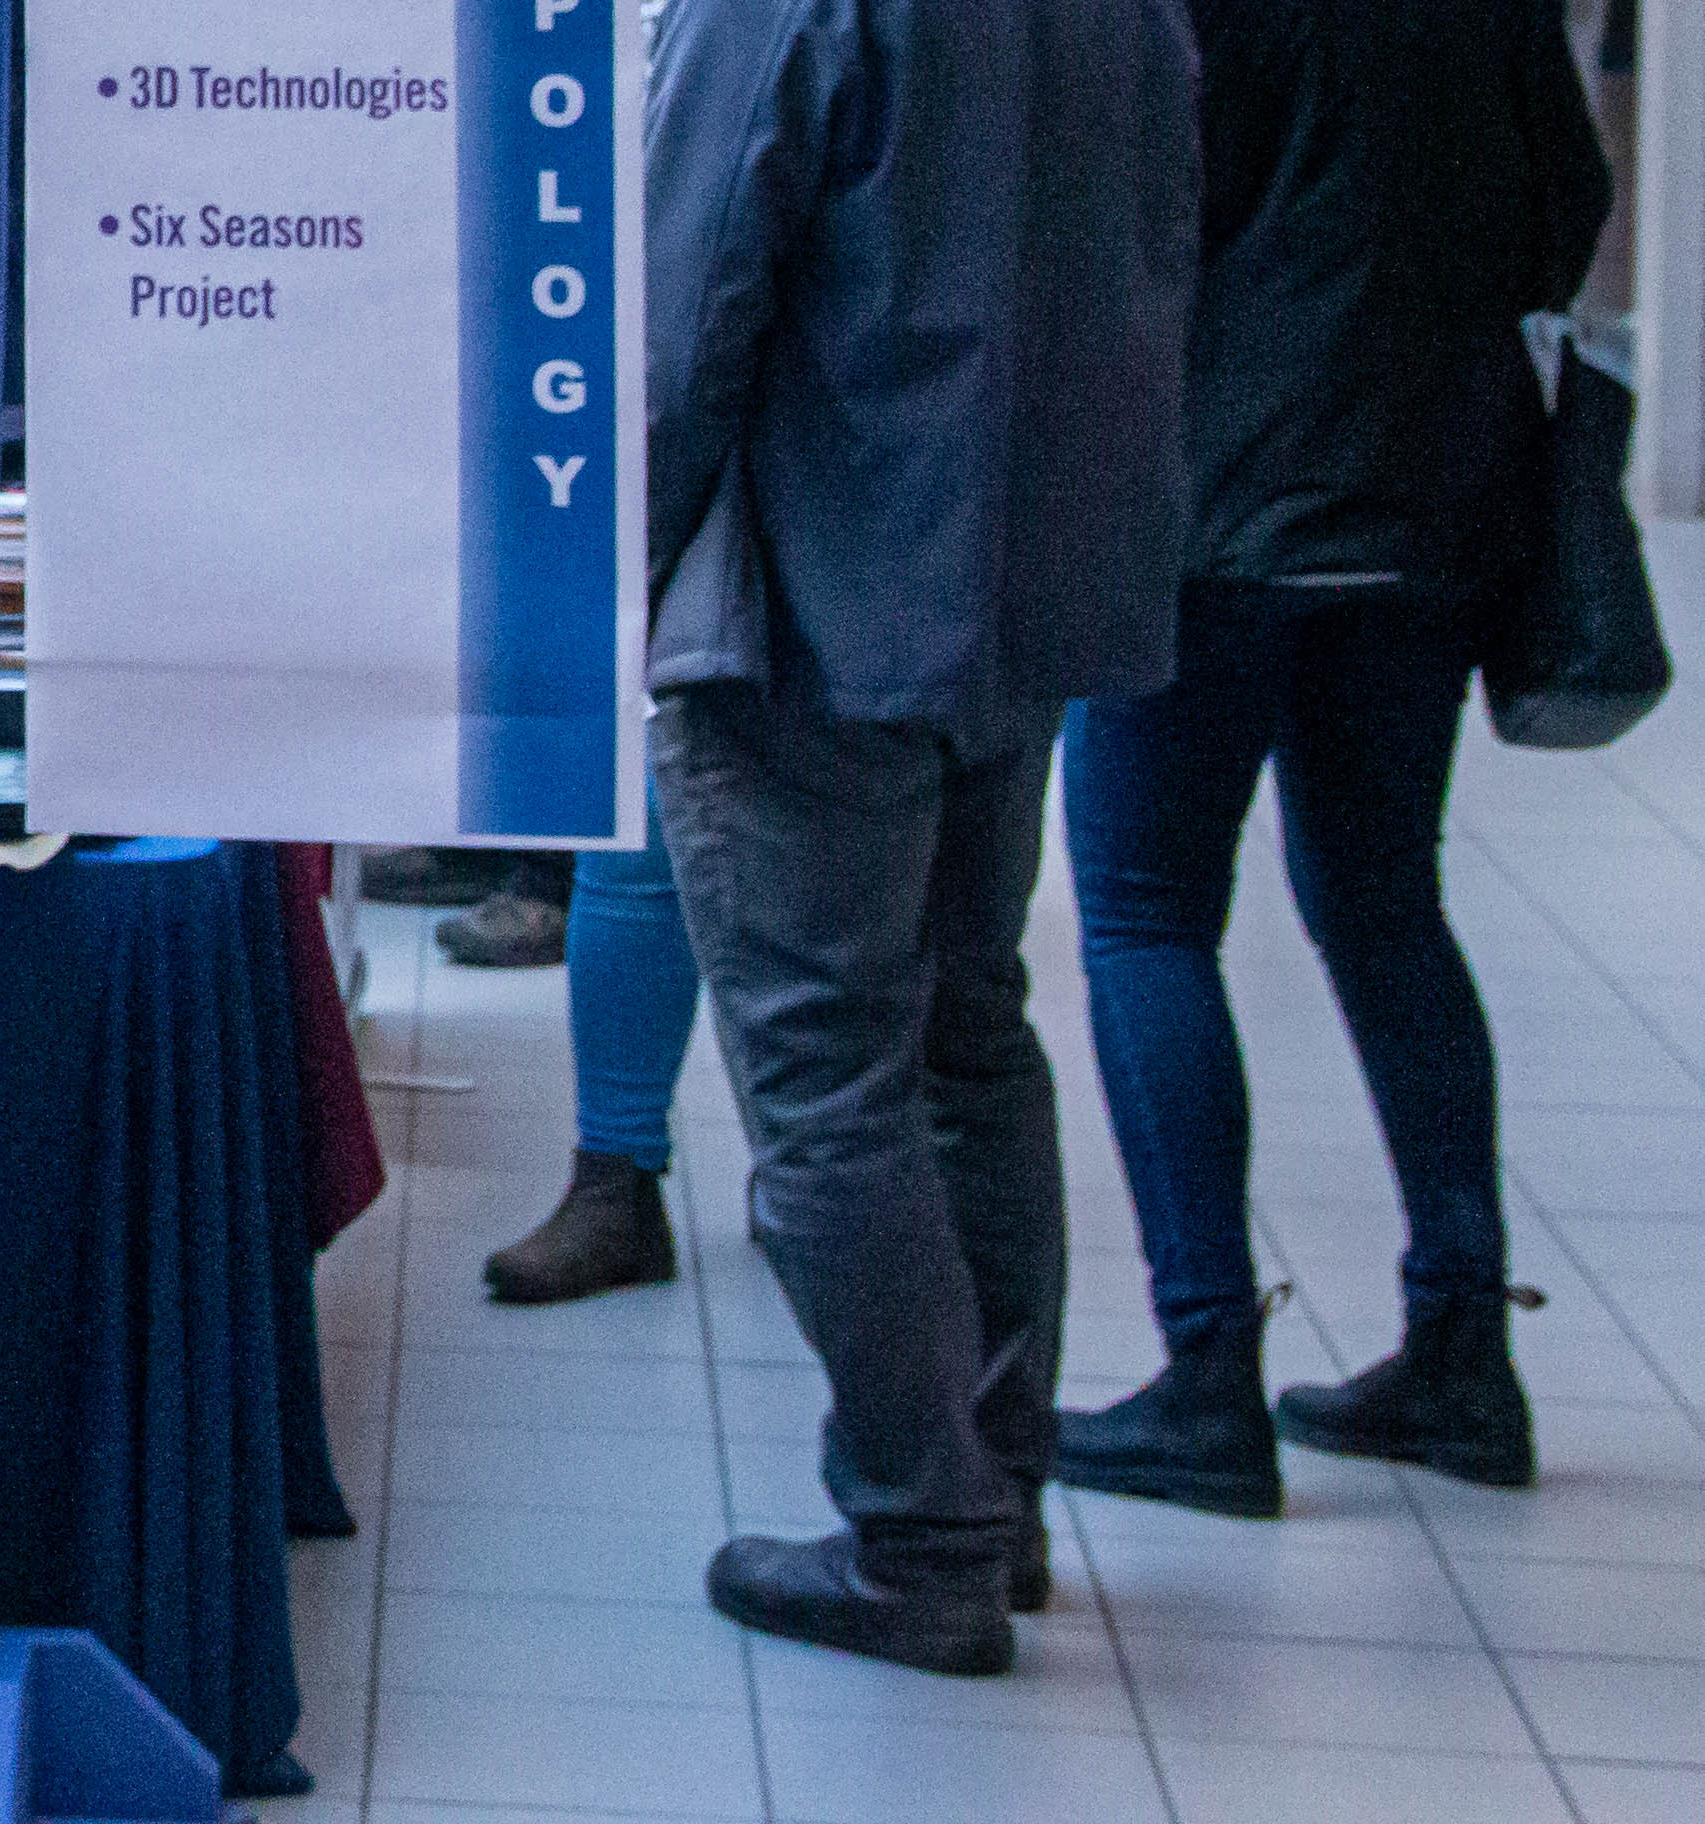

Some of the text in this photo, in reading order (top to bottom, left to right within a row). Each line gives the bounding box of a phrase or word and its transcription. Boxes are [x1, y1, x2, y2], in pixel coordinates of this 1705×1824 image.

[130, 65, 449, 120] 3D Technologies
[130, 204, 364, 250] Six Seasons
[130, 274, 276, 328] Project
